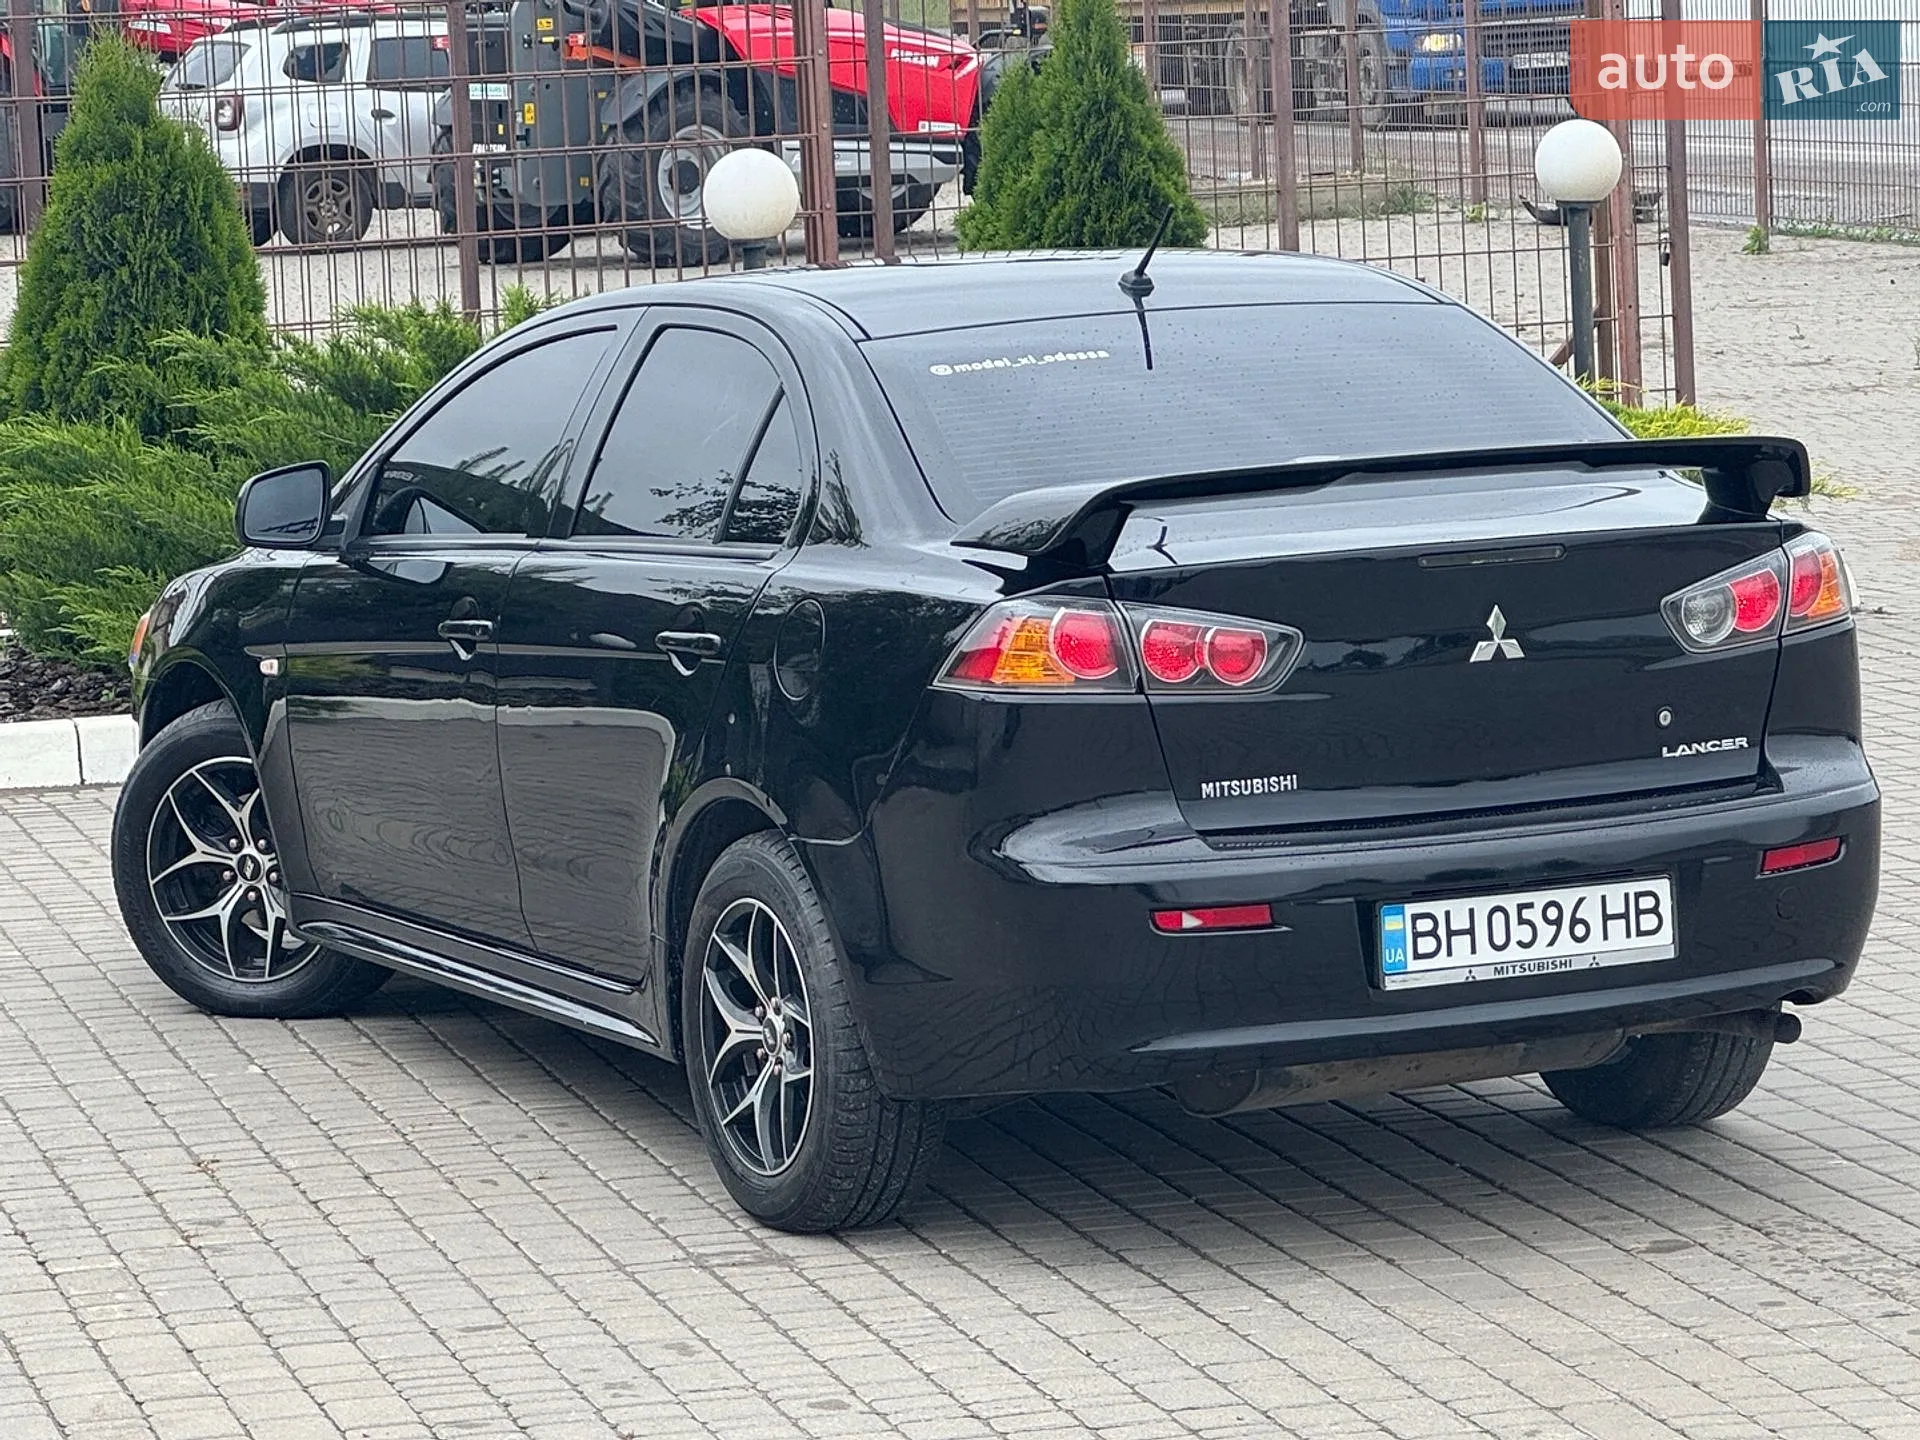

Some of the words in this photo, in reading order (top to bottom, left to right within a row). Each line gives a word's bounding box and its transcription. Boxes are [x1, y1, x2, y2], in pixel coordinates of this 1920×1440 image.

[1662, 737, 1749, 758] LANCER
[1201, 774, 1298, 799] MITSUBISHI
[1411, 908, 1477, 961] BH
[1487, 896, 1591, 952] 0596
[1601, 890, 1664, 941] HB
[1385, 947, 1405, 964] UA
[1493, 959, 1573, 977] MITSUBISHI
